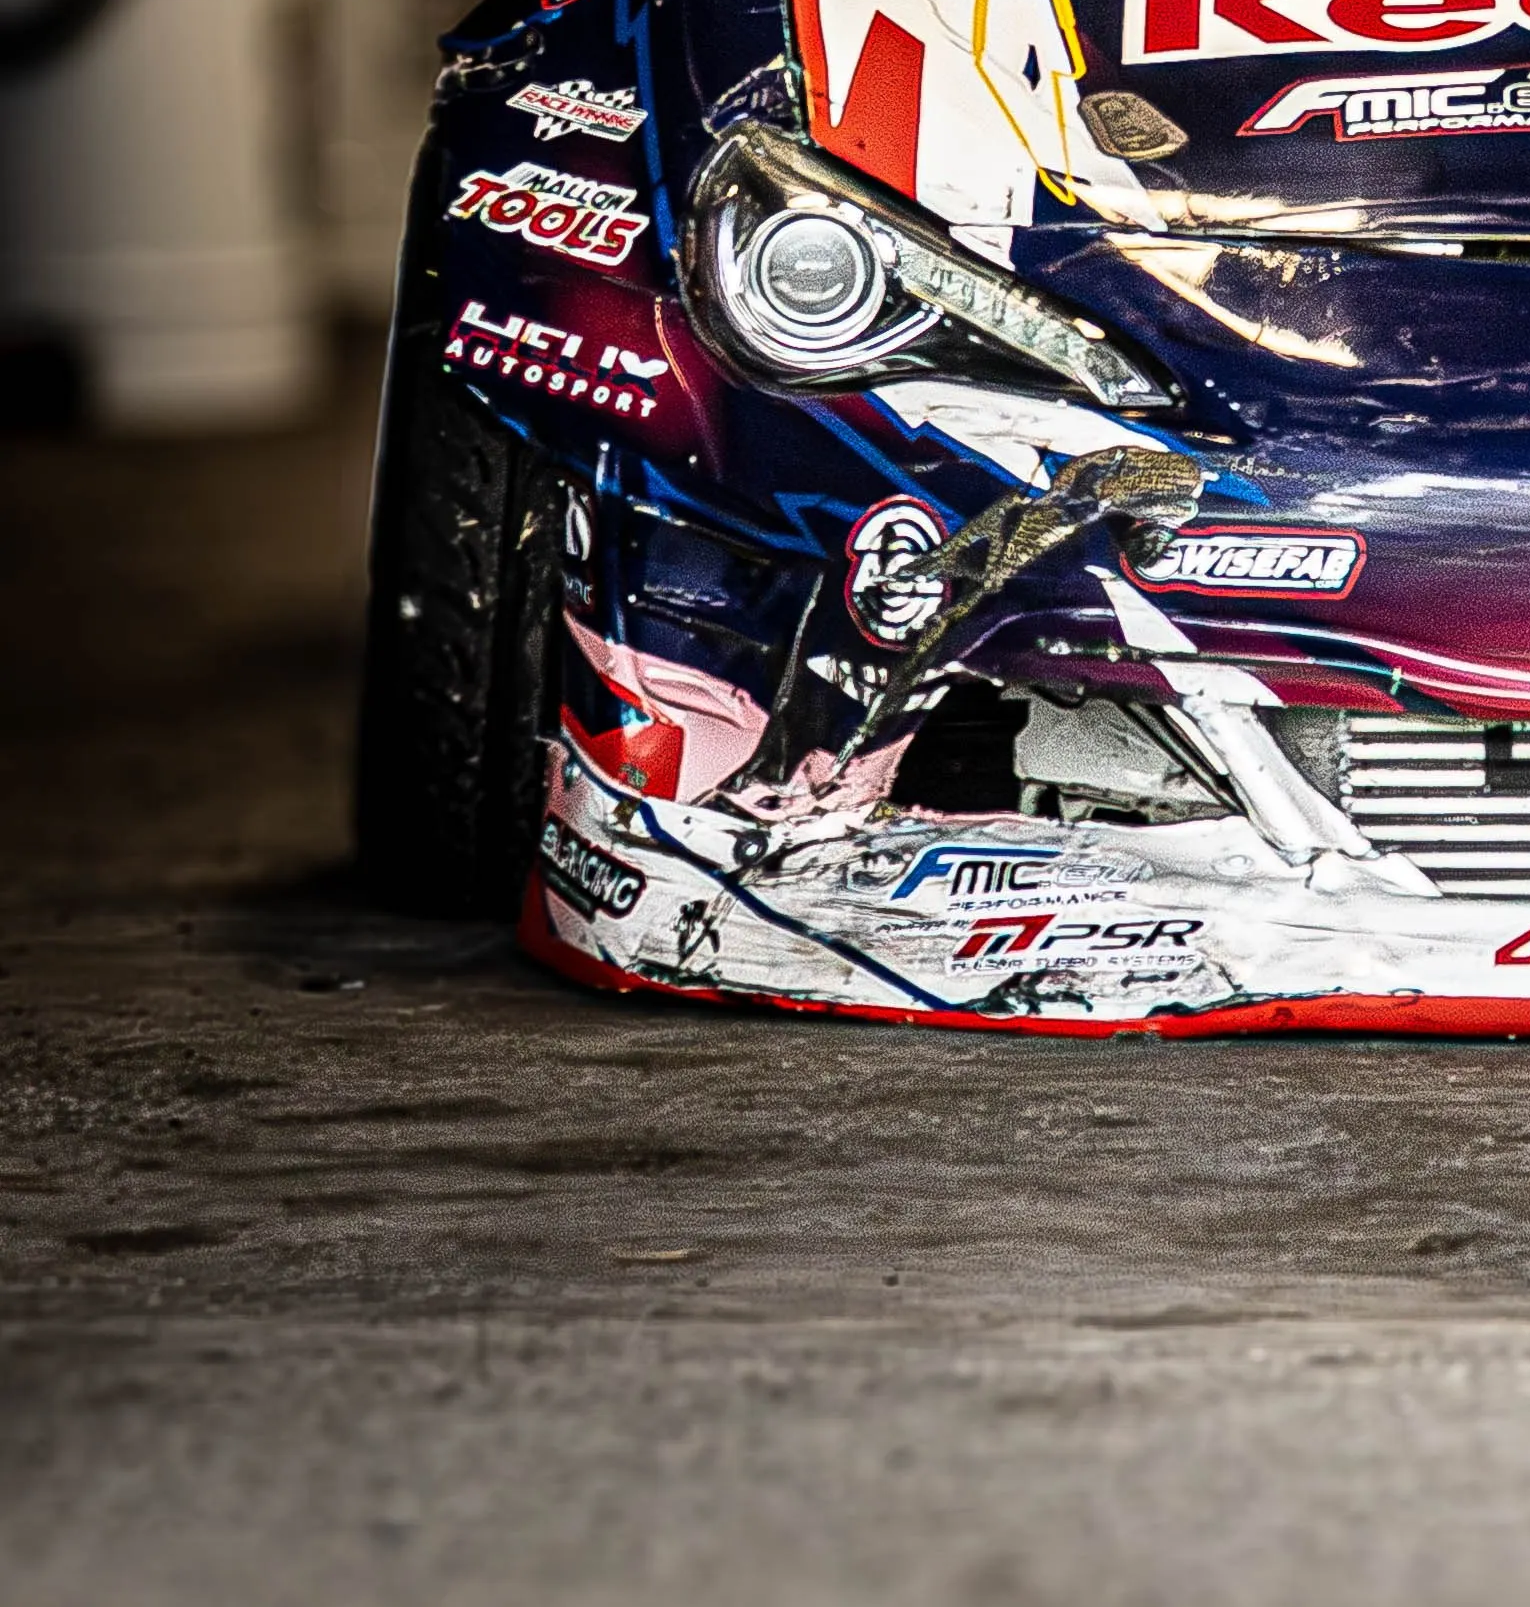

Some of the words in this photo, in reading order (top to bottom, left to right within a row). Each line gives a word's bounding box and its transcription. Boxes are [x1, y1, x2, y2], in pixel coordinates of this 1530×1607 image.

[456, 176, 643, 258] TOOLS
[445, 337, 658, 418] AUTOSPORT
[1180, 543, 1356, 582] WISEFAB
